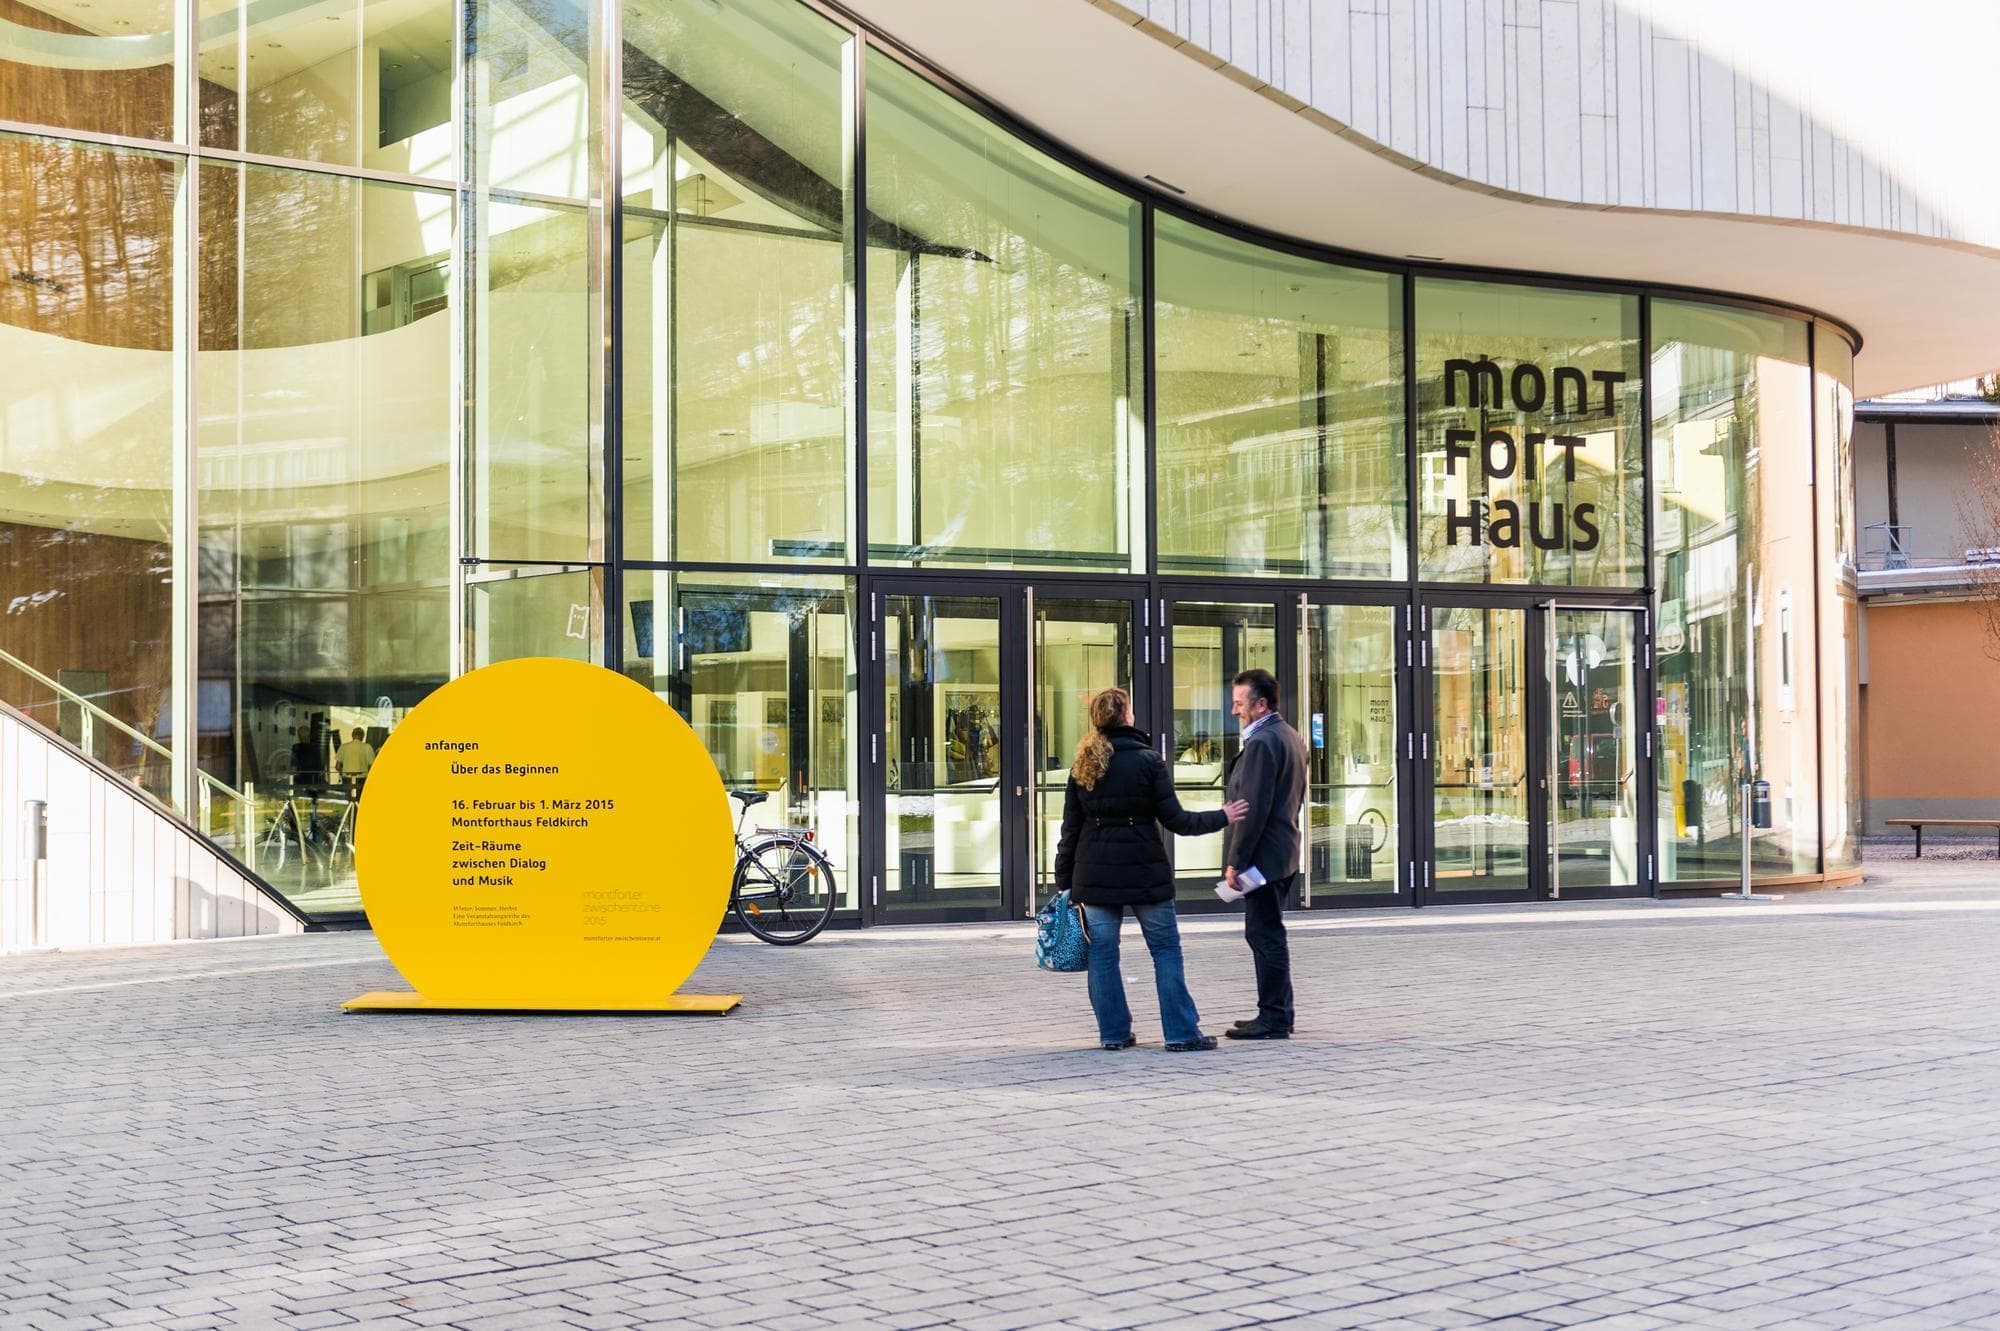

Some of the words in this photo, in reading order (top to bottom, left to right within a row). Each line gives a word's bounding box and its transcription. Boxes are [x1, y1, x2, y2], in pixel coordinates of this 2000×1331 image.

[424, 739, 479, 753] anfangen
[450, 760, 478, 775] Über
[481, 763, 502, 775] das
[504, 763, 560, 777] Beginnen
[451, 799, 469, 810] 16.
[472, 799, 517, 810] Februar
[519, 799, 536, 810] bis
[539, 799, 550, 810] 1.
[551, 799, 582, 810] März
[584, 799, 615, 810] 2015
[451, 816, 533, 828] Montforthaus
[536, 816, 589, 828] Feldkirch
[451, 840, 522, 852] Zeit-Räume
[451, 857, 506, 869] zwischen
[509, 857, 547, 872] Dialog
[452, 875, 475, 886] und
[478, 875, 514, 886] Musik
